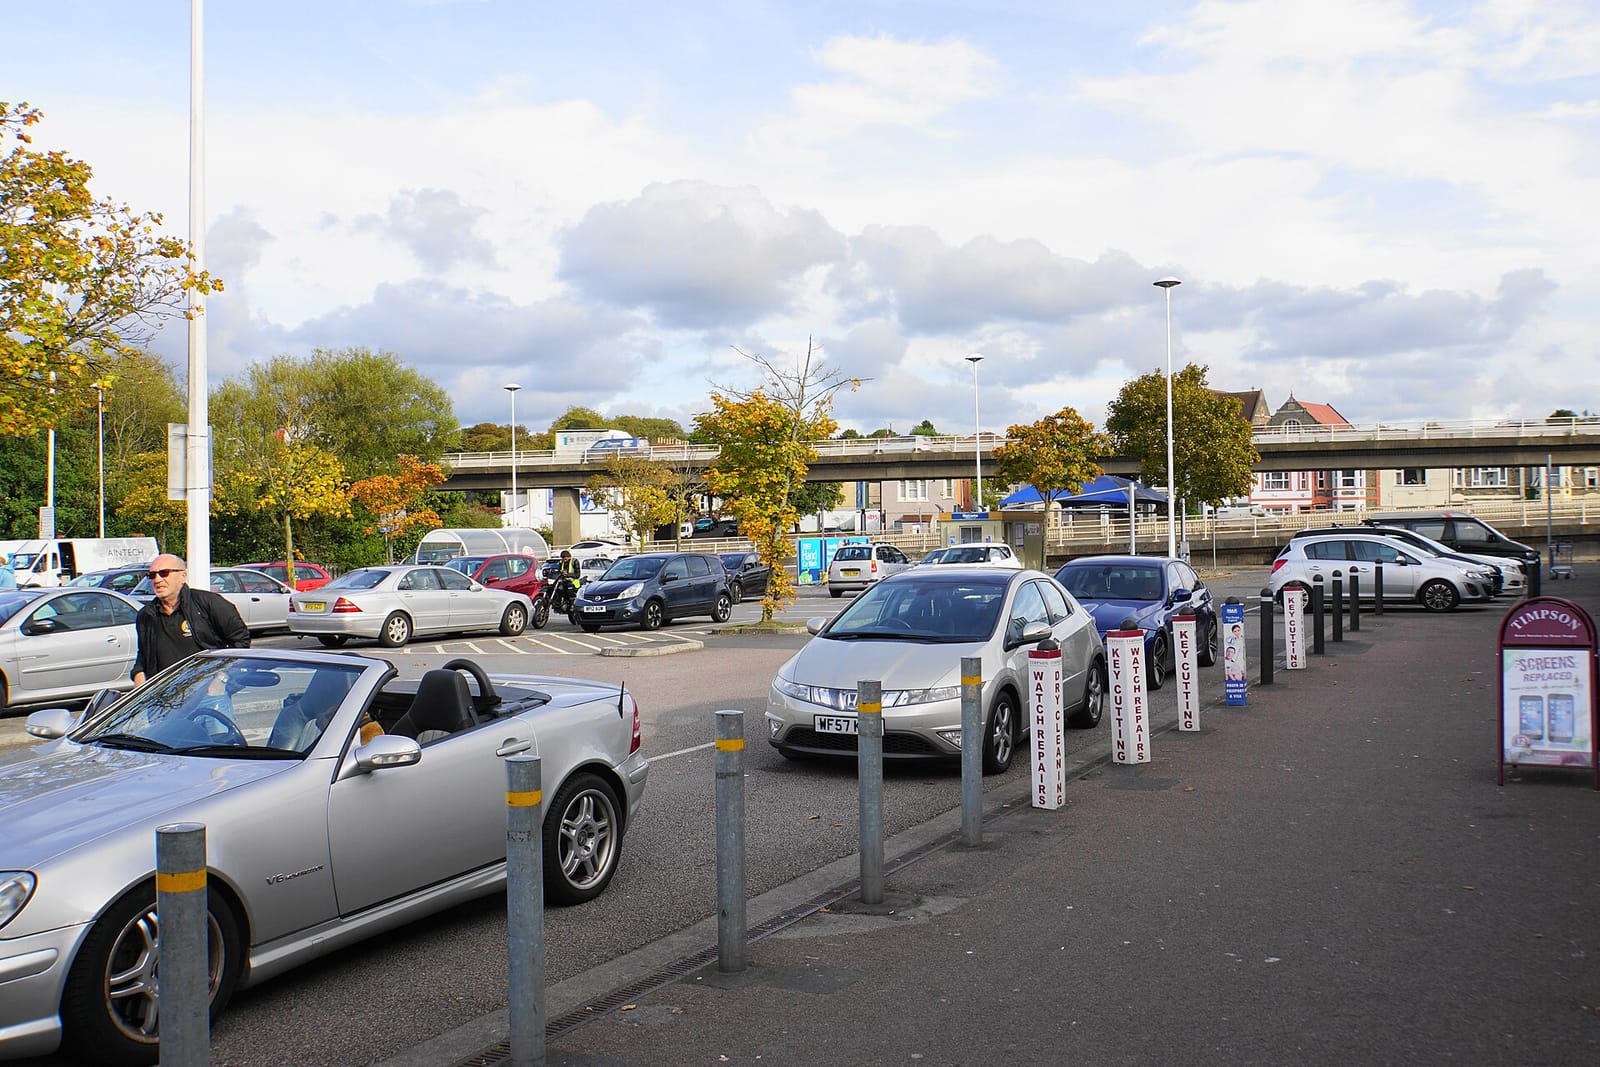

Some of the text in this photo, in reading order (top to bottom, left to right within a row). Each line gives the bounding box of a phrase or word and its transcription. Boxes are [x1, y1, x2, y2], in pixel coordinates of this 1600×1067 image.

[1510, 609, 1581, 630] TIMPSON
[1289, 619, 1298, 668] CUTTING
[1519, 655, 1576, 672] SCREENS
[1112, 648, 1121, 681] KEY
[1179, 630, 1193, 729] KEY CUTTING
[1523, 671, 1573, 682] REPLACED
[1113, 684, 1126, 761] CUTTING
[1130, 647, 1145, 761] WATCH REPAIRS
[819, 718, 850, 732] WF57
[1033, 671, 1046, 806] WATCH REPAIRS
[1055, 711, 1063, 806] CLEANING
[265, 873, 284, 886] V6
